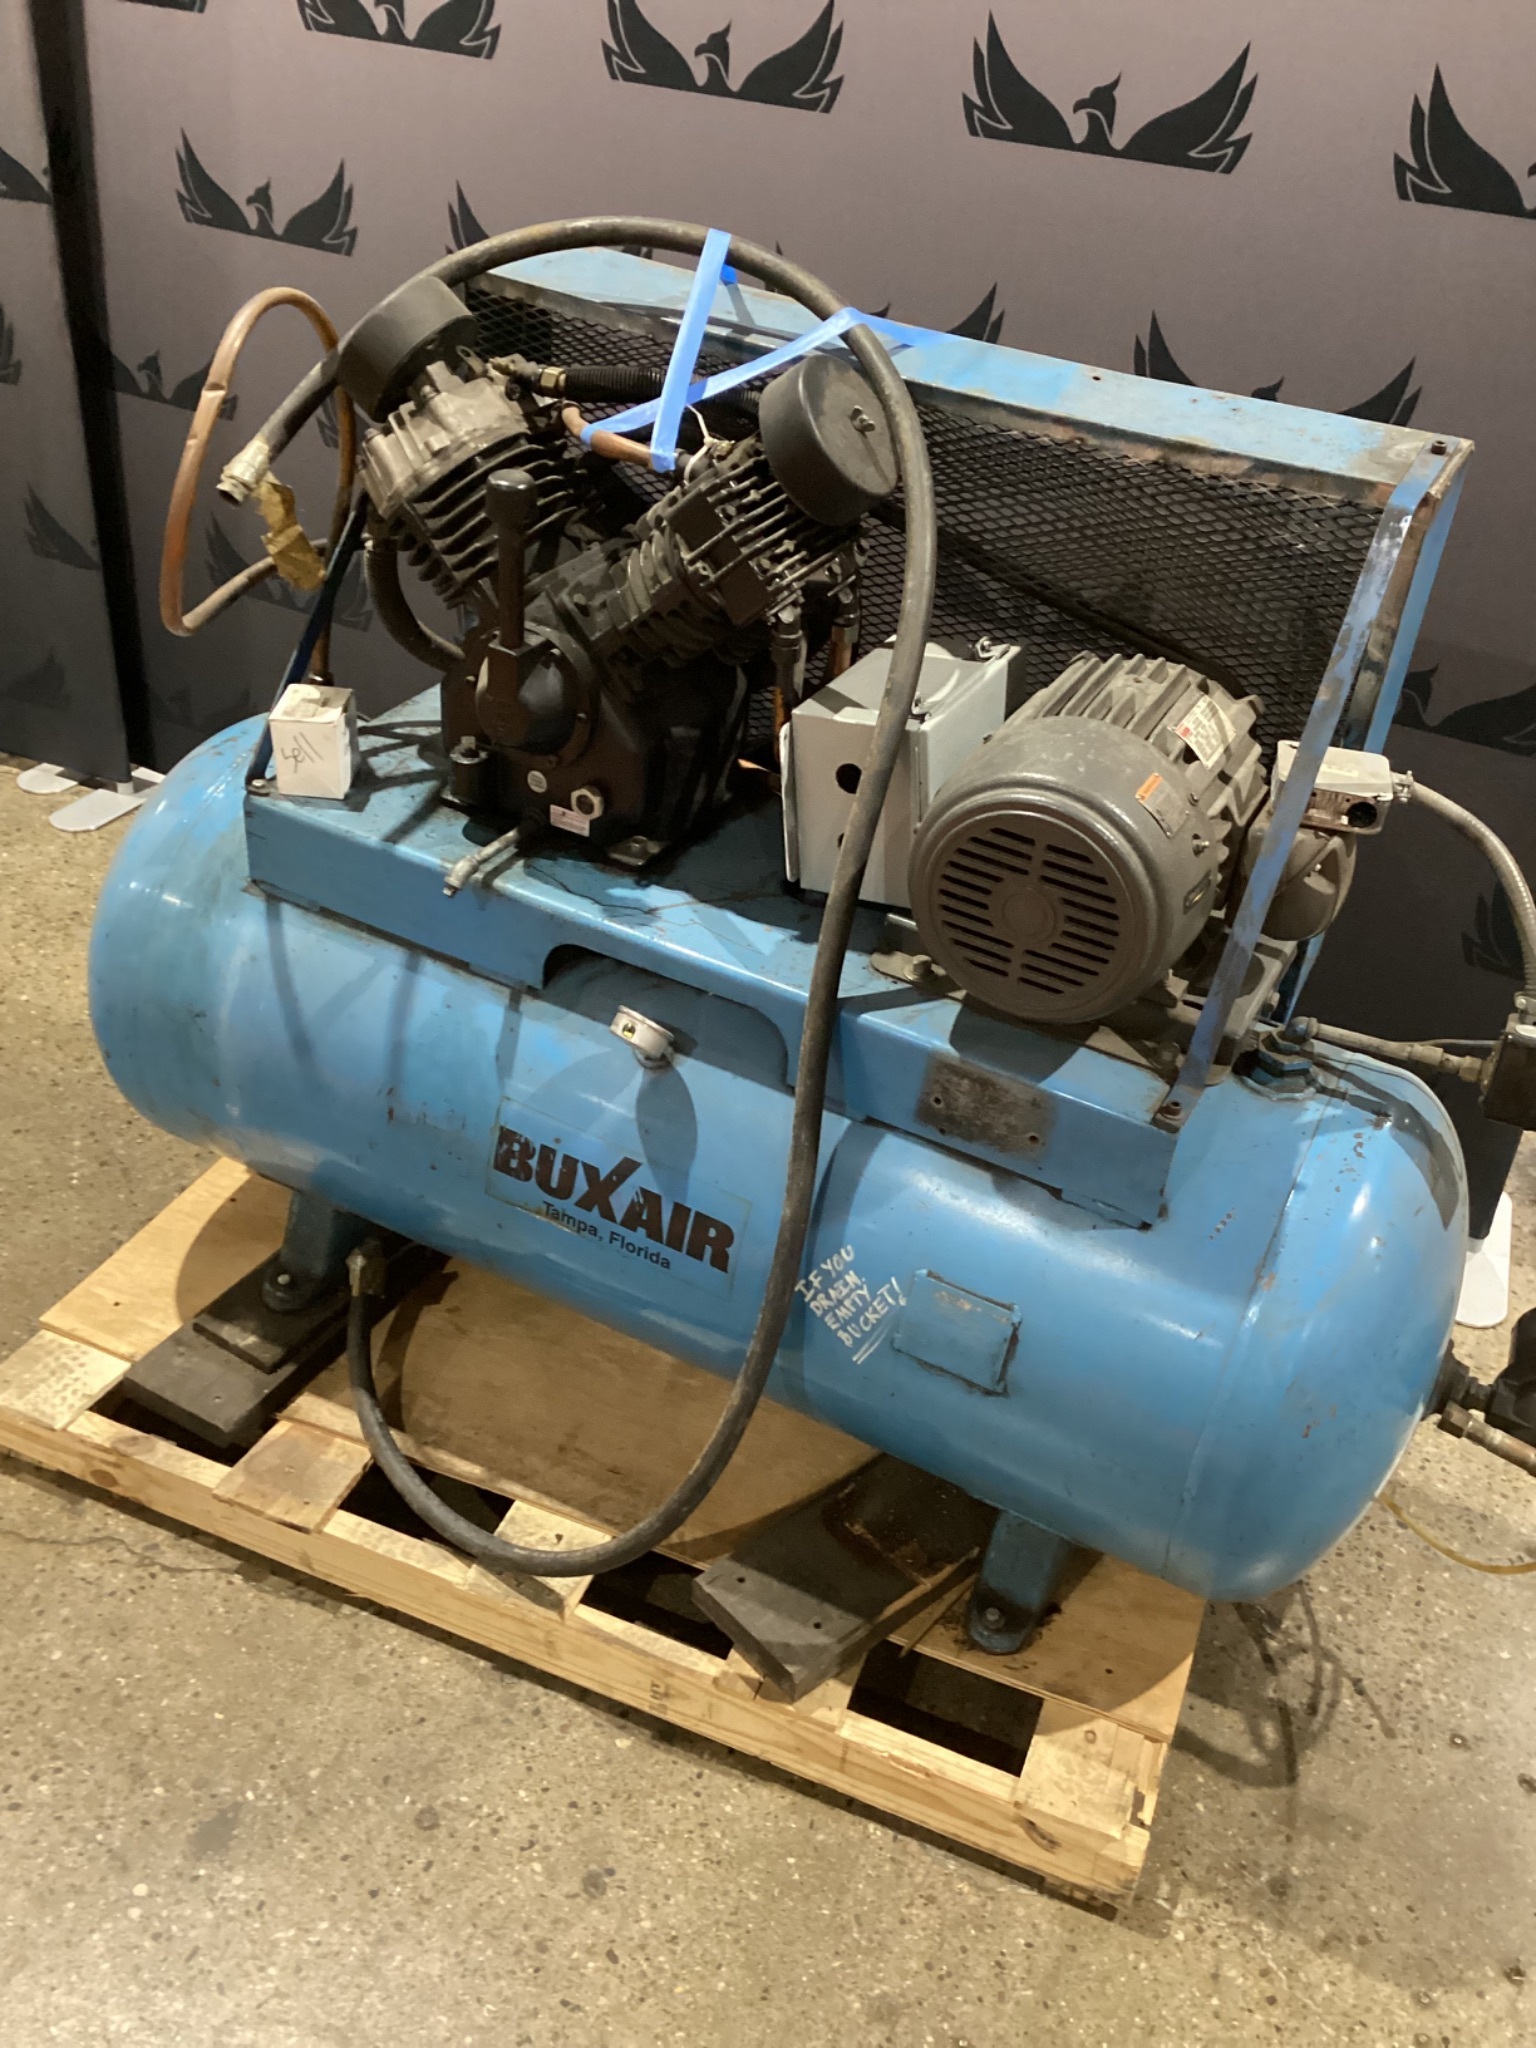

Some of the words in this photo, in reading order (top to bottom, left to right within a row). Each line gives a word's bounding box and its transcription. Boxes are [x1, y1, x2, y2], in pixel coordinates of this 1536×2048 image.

[493, 1125, 735, 1274] BUXAIR
[543, 1200, 604, 1241] Tampa,
[608, 1230, 672, 1270] Florida
[794, 1269, 823, 1303] IF
[820, 1244, 856, 1279] YOU
[824, 1284, 871, 1331] EMPTY
[837, 1276, 907, 1348] BUCKET!
